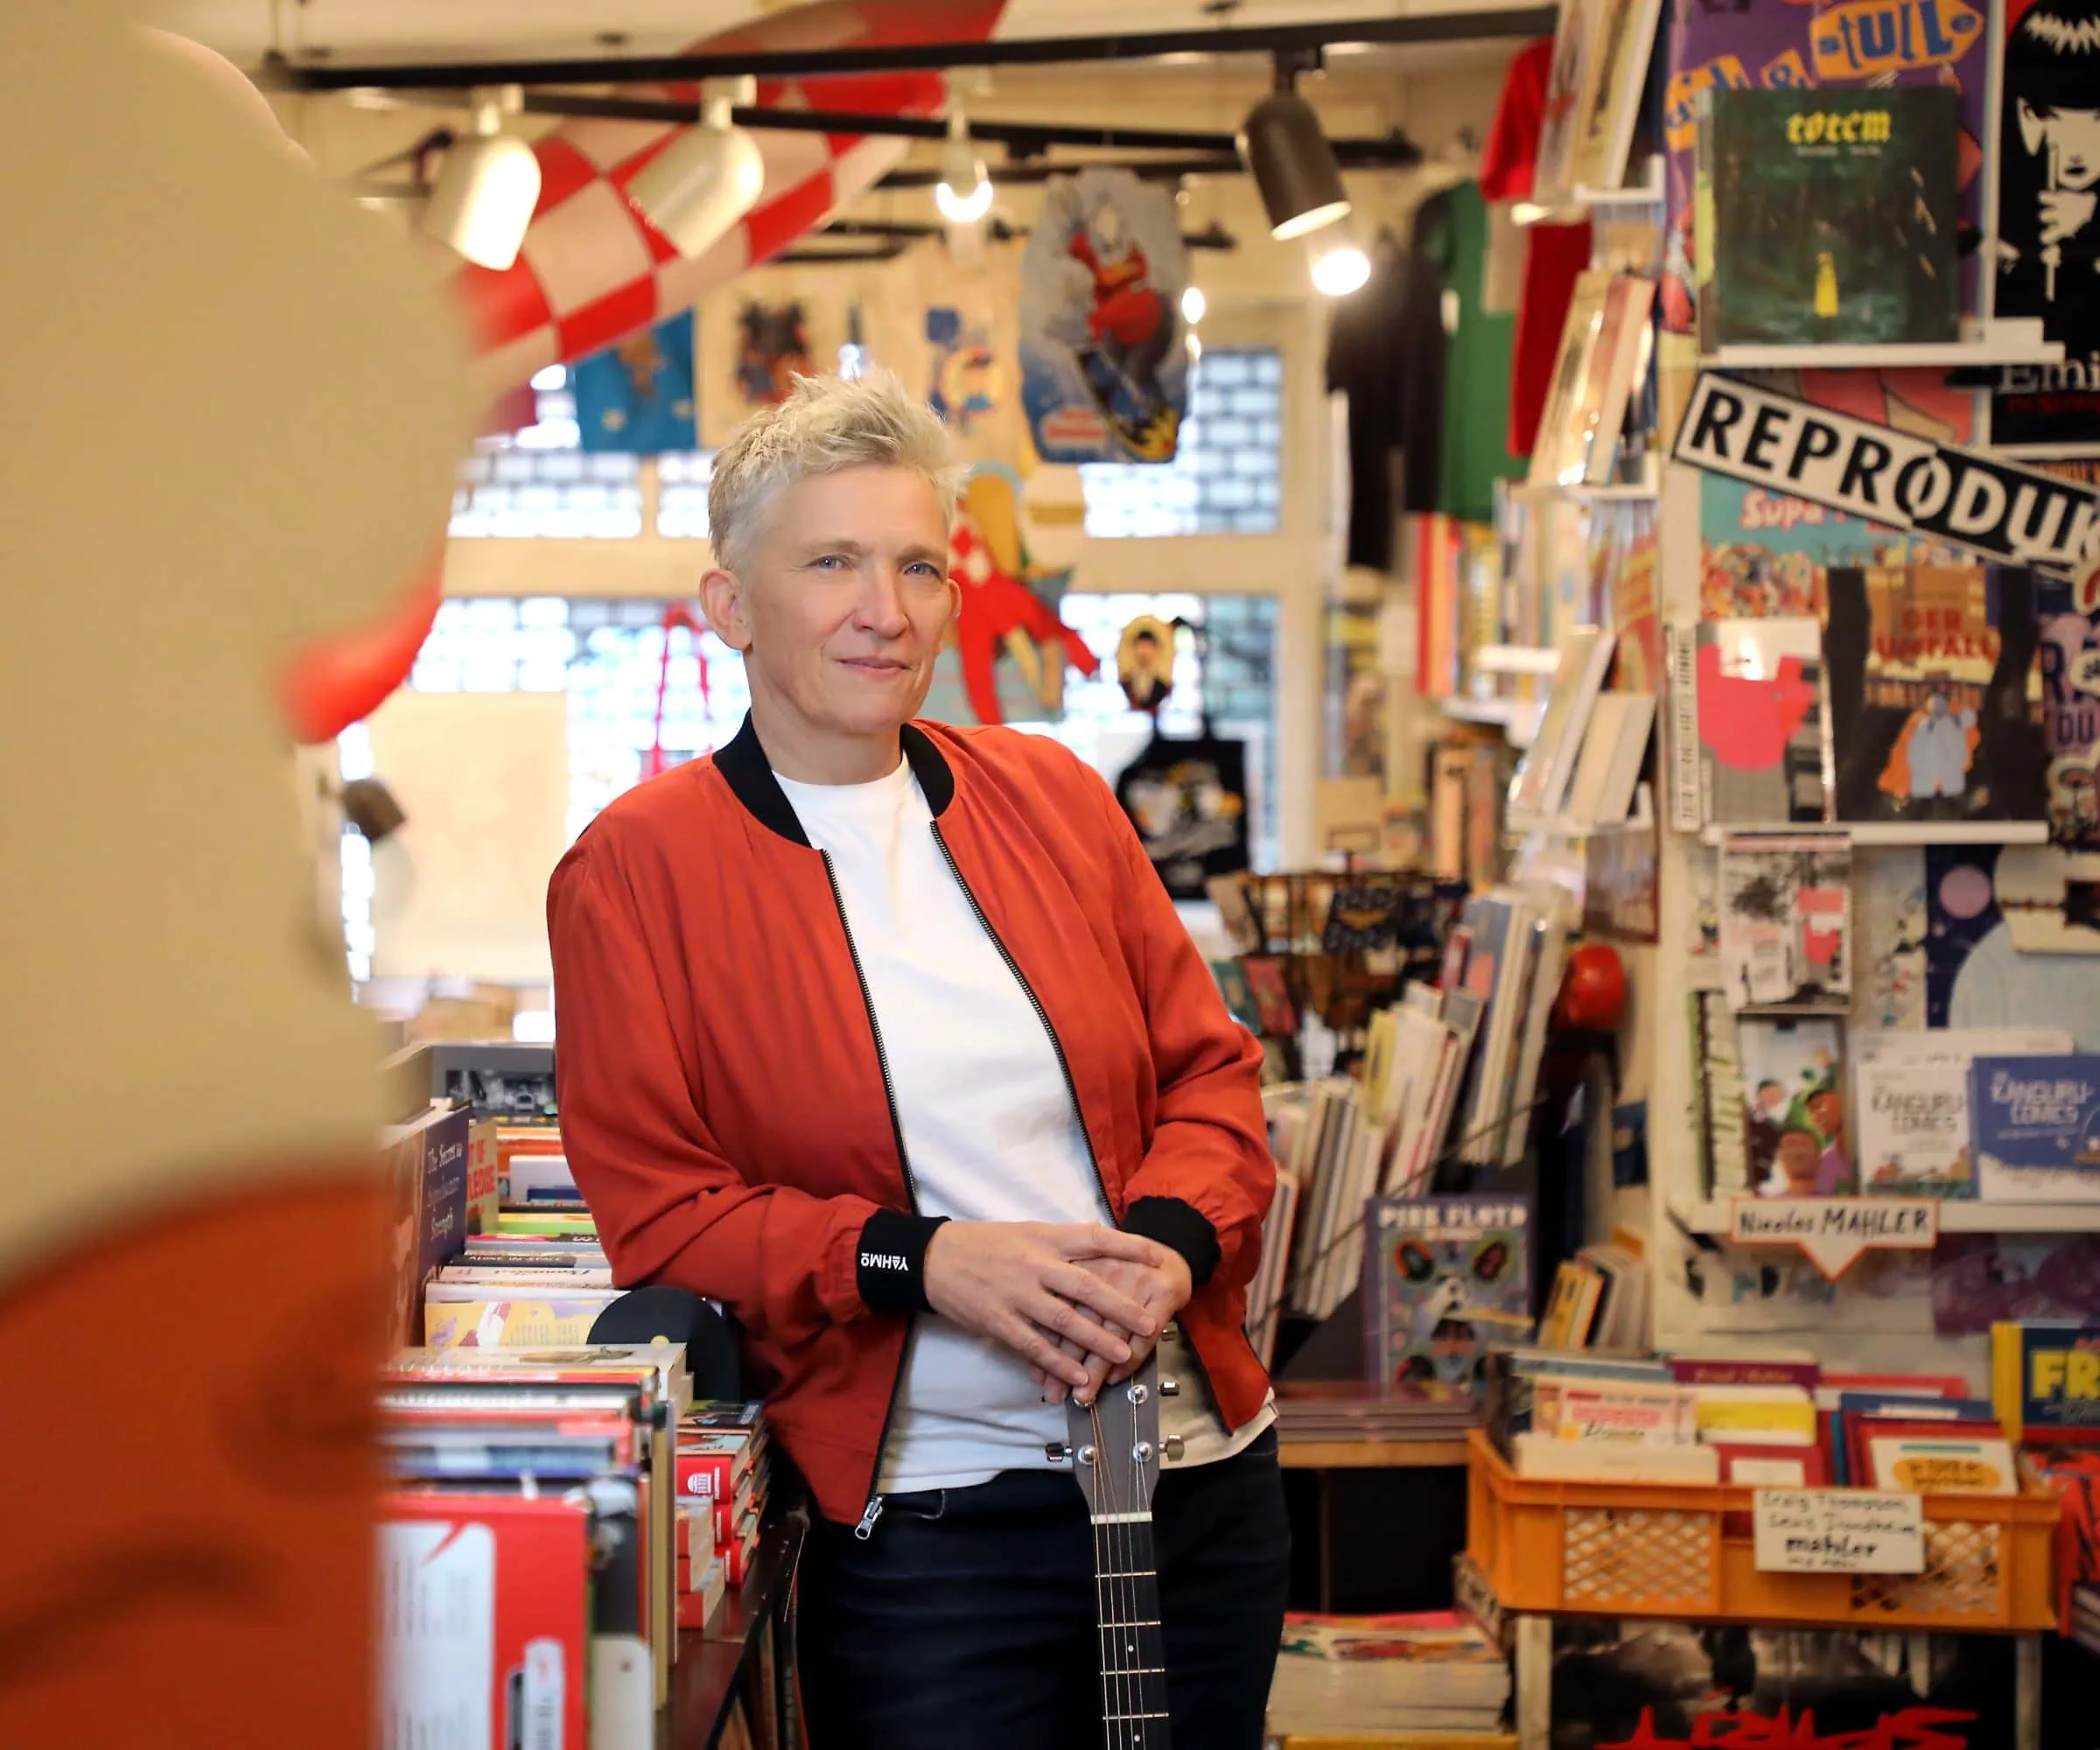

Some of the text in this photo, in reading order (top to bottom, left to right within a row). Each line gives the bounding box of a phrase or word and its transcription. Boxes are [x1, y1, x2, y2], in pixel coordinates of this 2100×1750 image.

[467, 1166, 496, 1200] LEDGE
[1821, 1205, 1928, 1238] MAHLER
[860, 1252, 909, 1271] YAHMO
[1785, 1533, 1879, 1558] mahler
